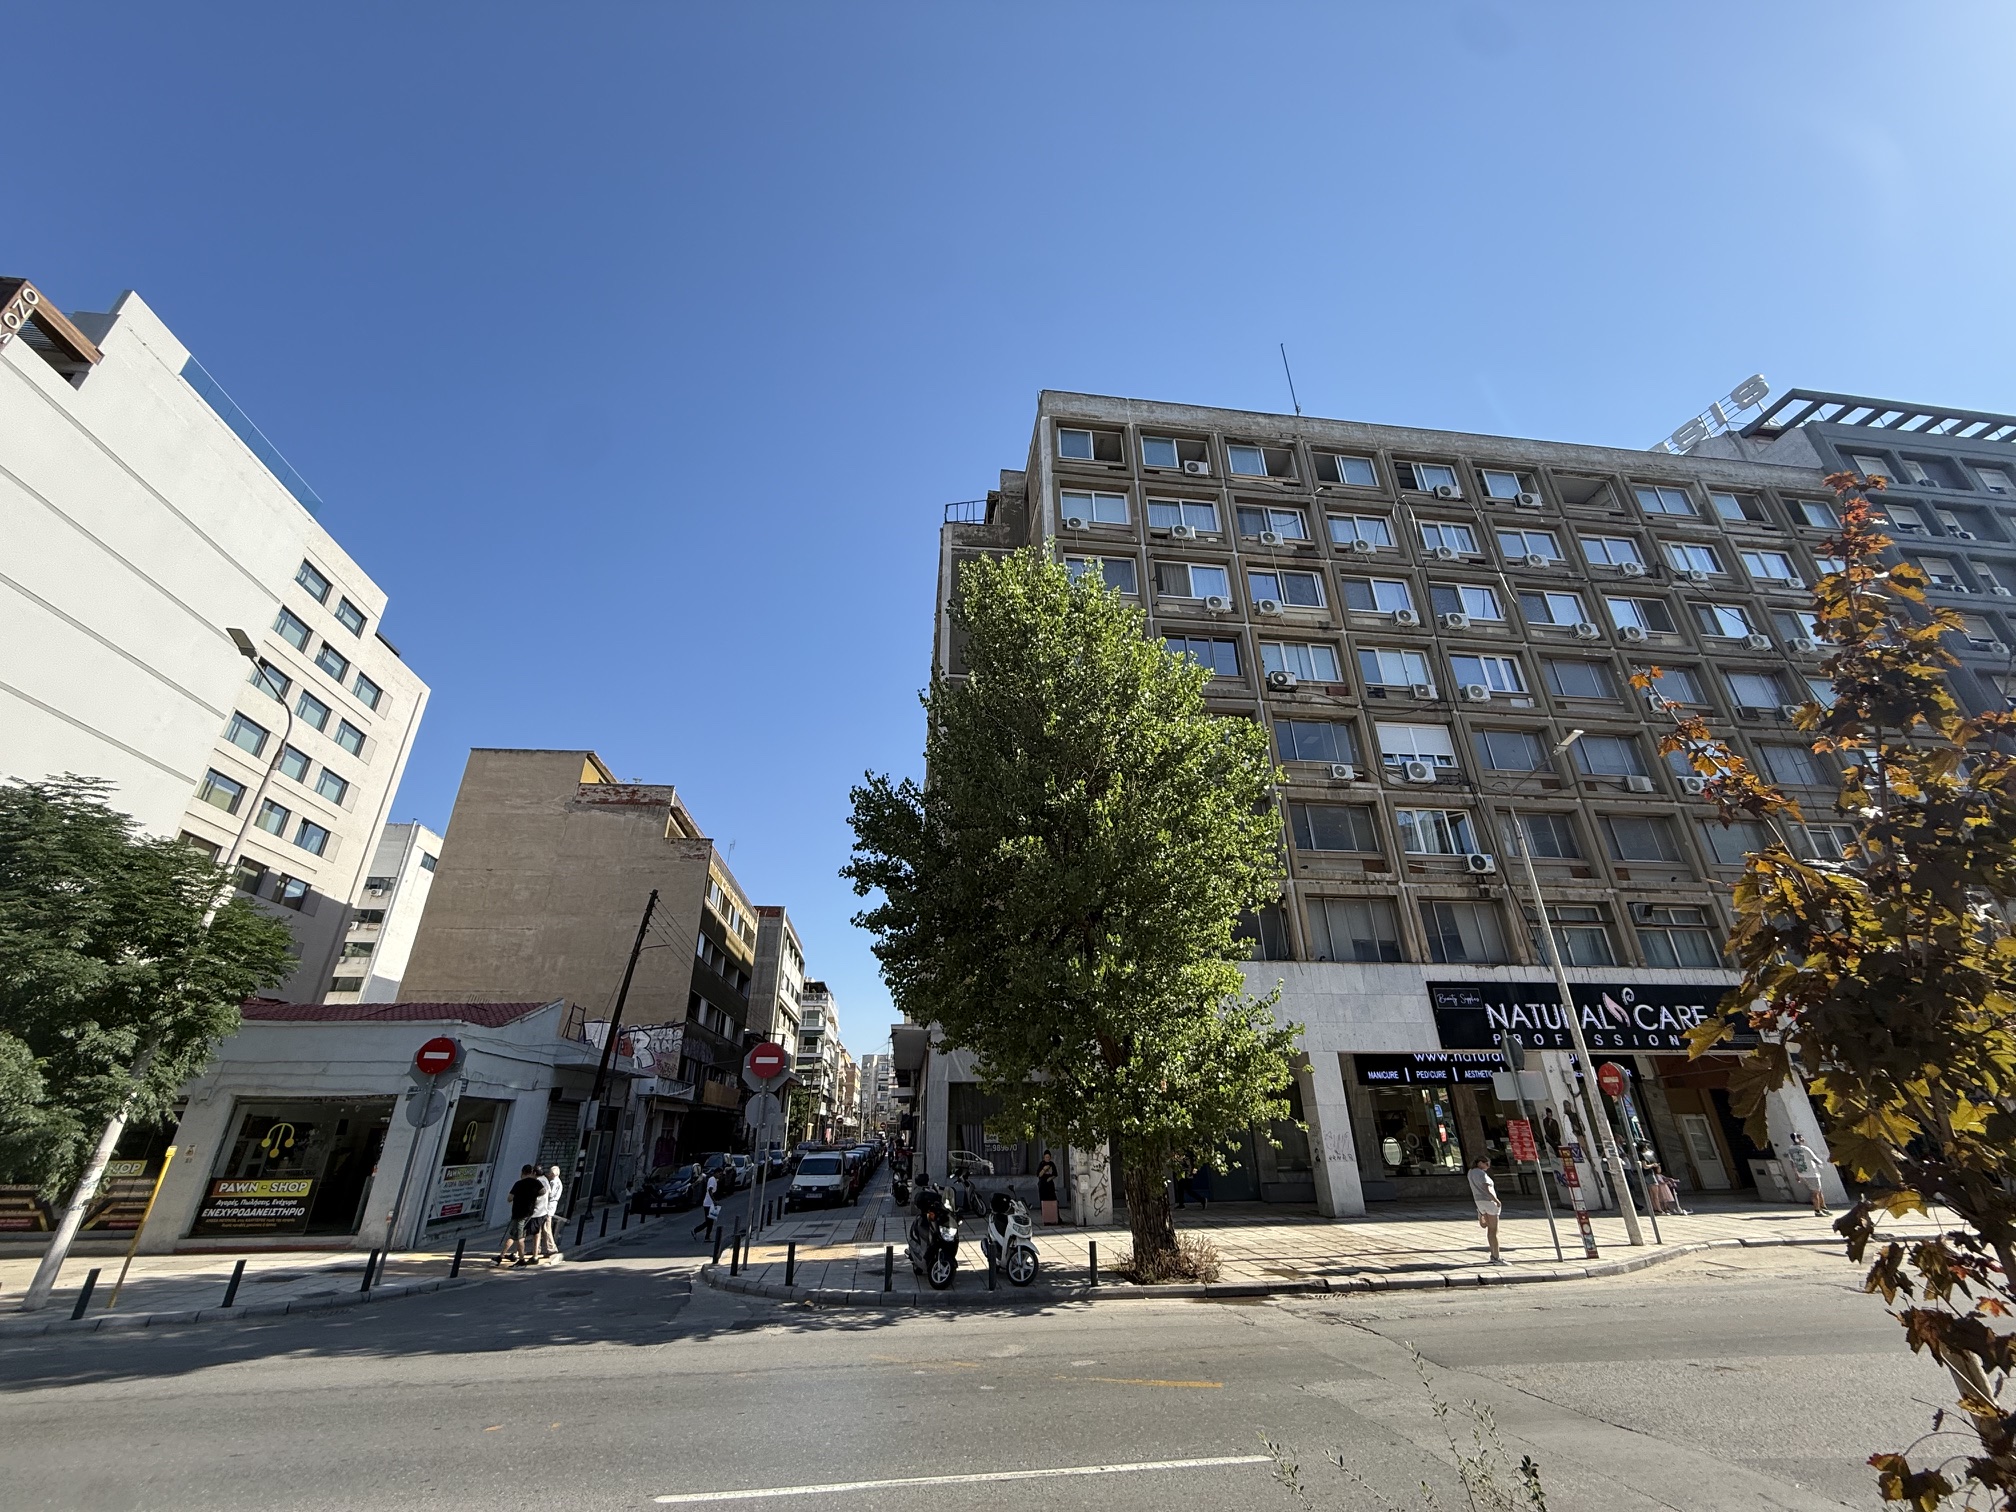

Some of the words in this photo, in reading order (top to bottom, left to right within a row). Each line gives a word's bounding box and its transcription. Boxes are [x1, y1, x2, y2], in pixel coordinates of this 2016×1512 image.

[1632, 1004, 1709, 1031] CARE
[1367, 1070, 1399, 1080] MANICURE
[1415, 1070, 1447, 1079] PEDICURE
[218, 1182, 259, 1192] PAWN
[270, 1182, 308, 1192] SHOP
[201, 1207, 306, 1217] ΕΝΕΧΥΡΟΔΑΝΕΙΣΤΗΡΙΟ
